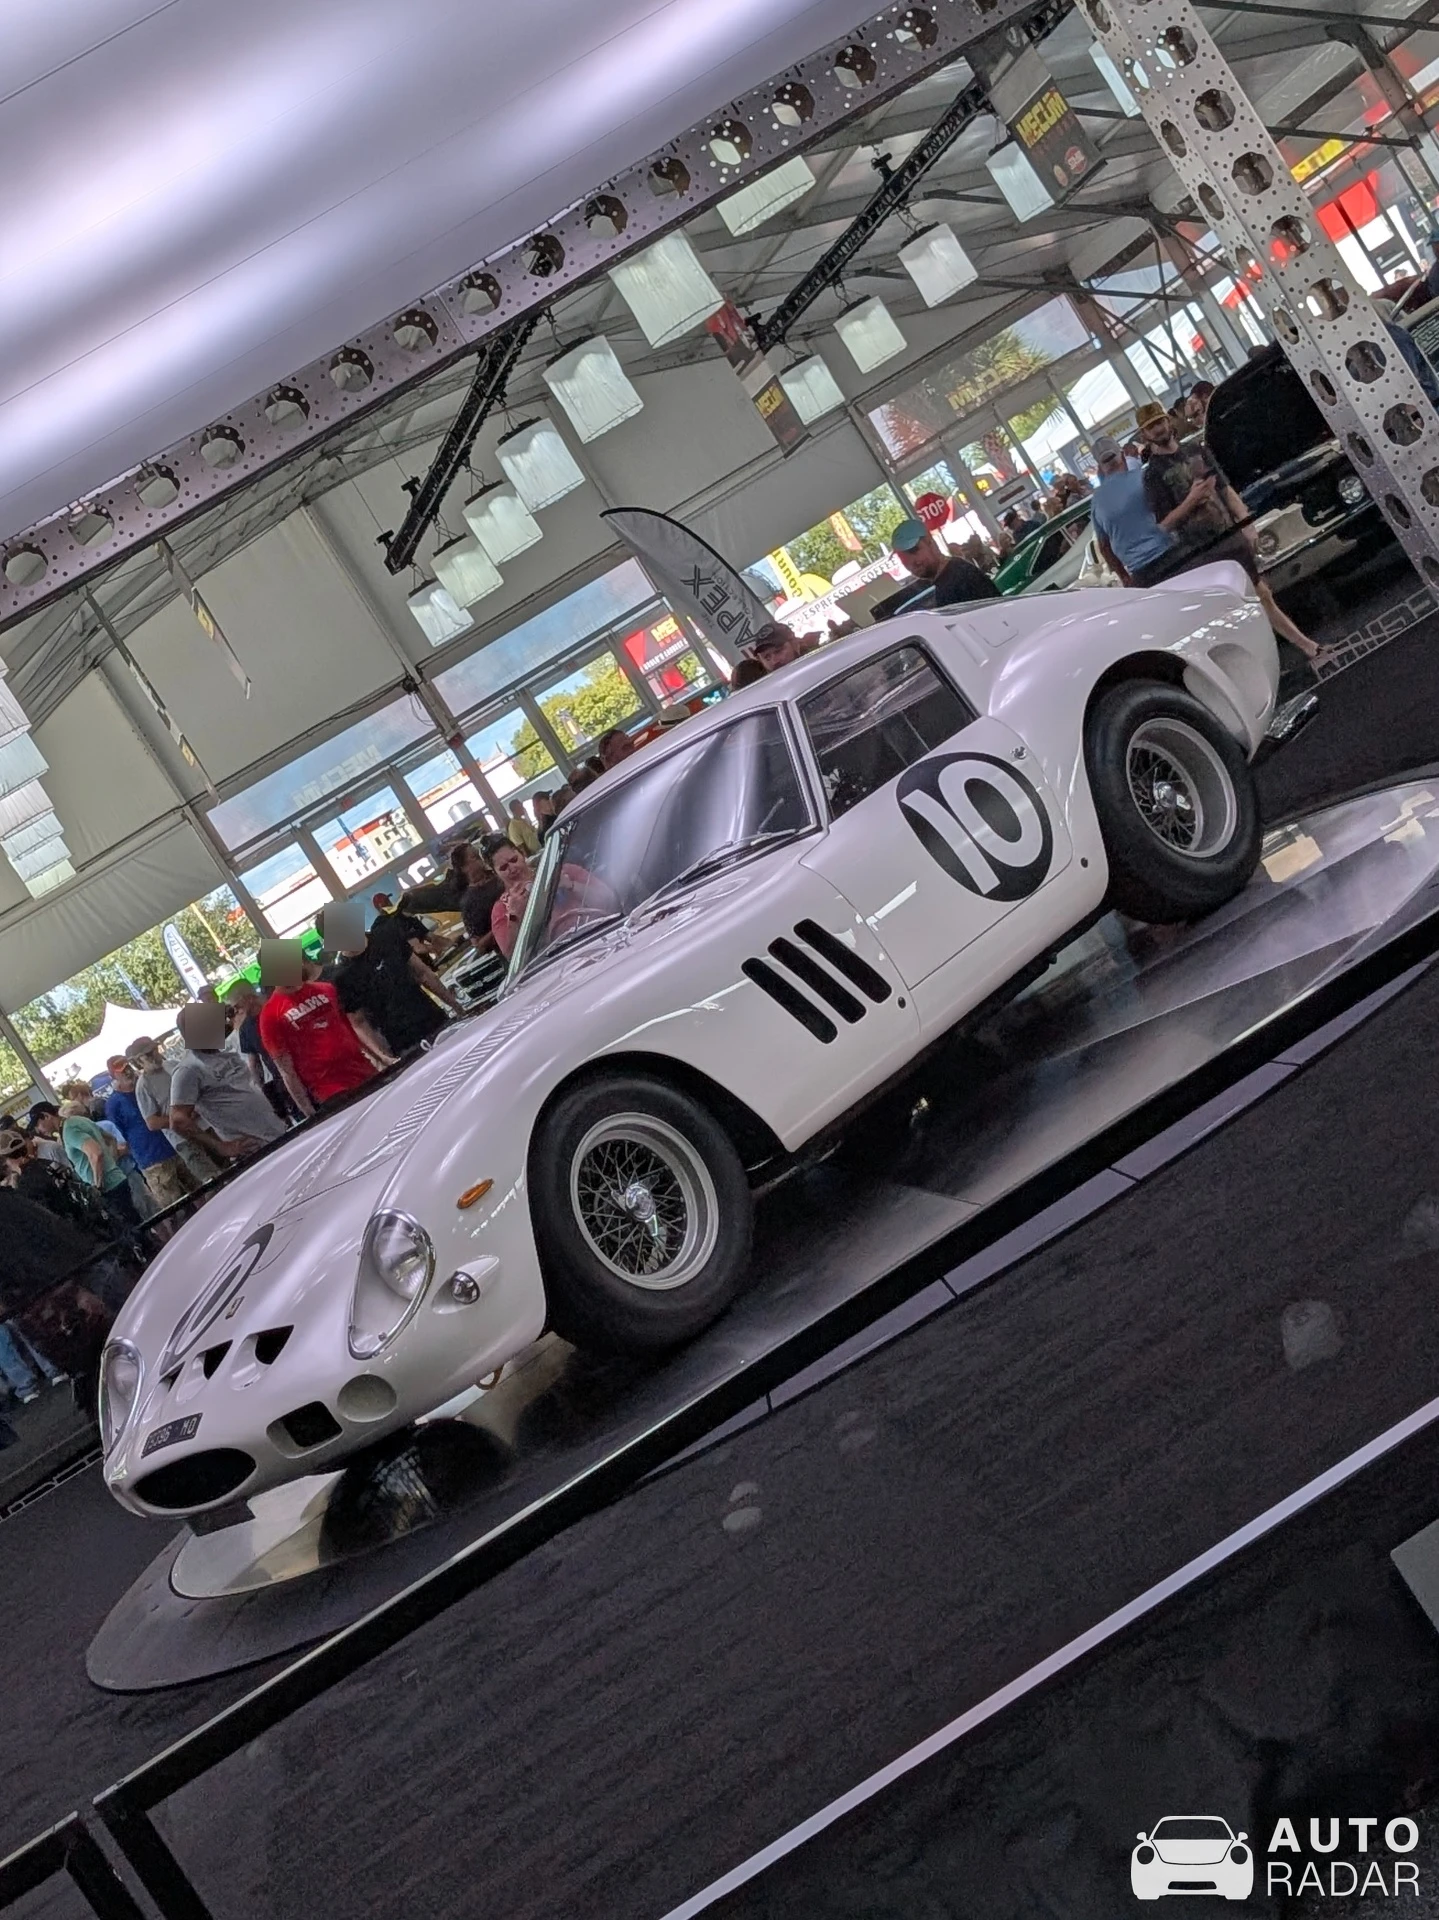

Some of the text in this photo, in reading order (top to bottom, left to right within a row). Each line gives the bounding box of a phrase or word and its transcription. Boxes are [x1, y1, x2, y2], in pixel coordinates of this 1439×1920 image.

[1016, 90, 1068, 149] MECUM
[917, 500, 945, 522] STOP
[680, 564, 758, 648] APEX
[803, 559, 898, 620] ESPRESSO COFFEE
[902, 760, 1043, 895] 10
